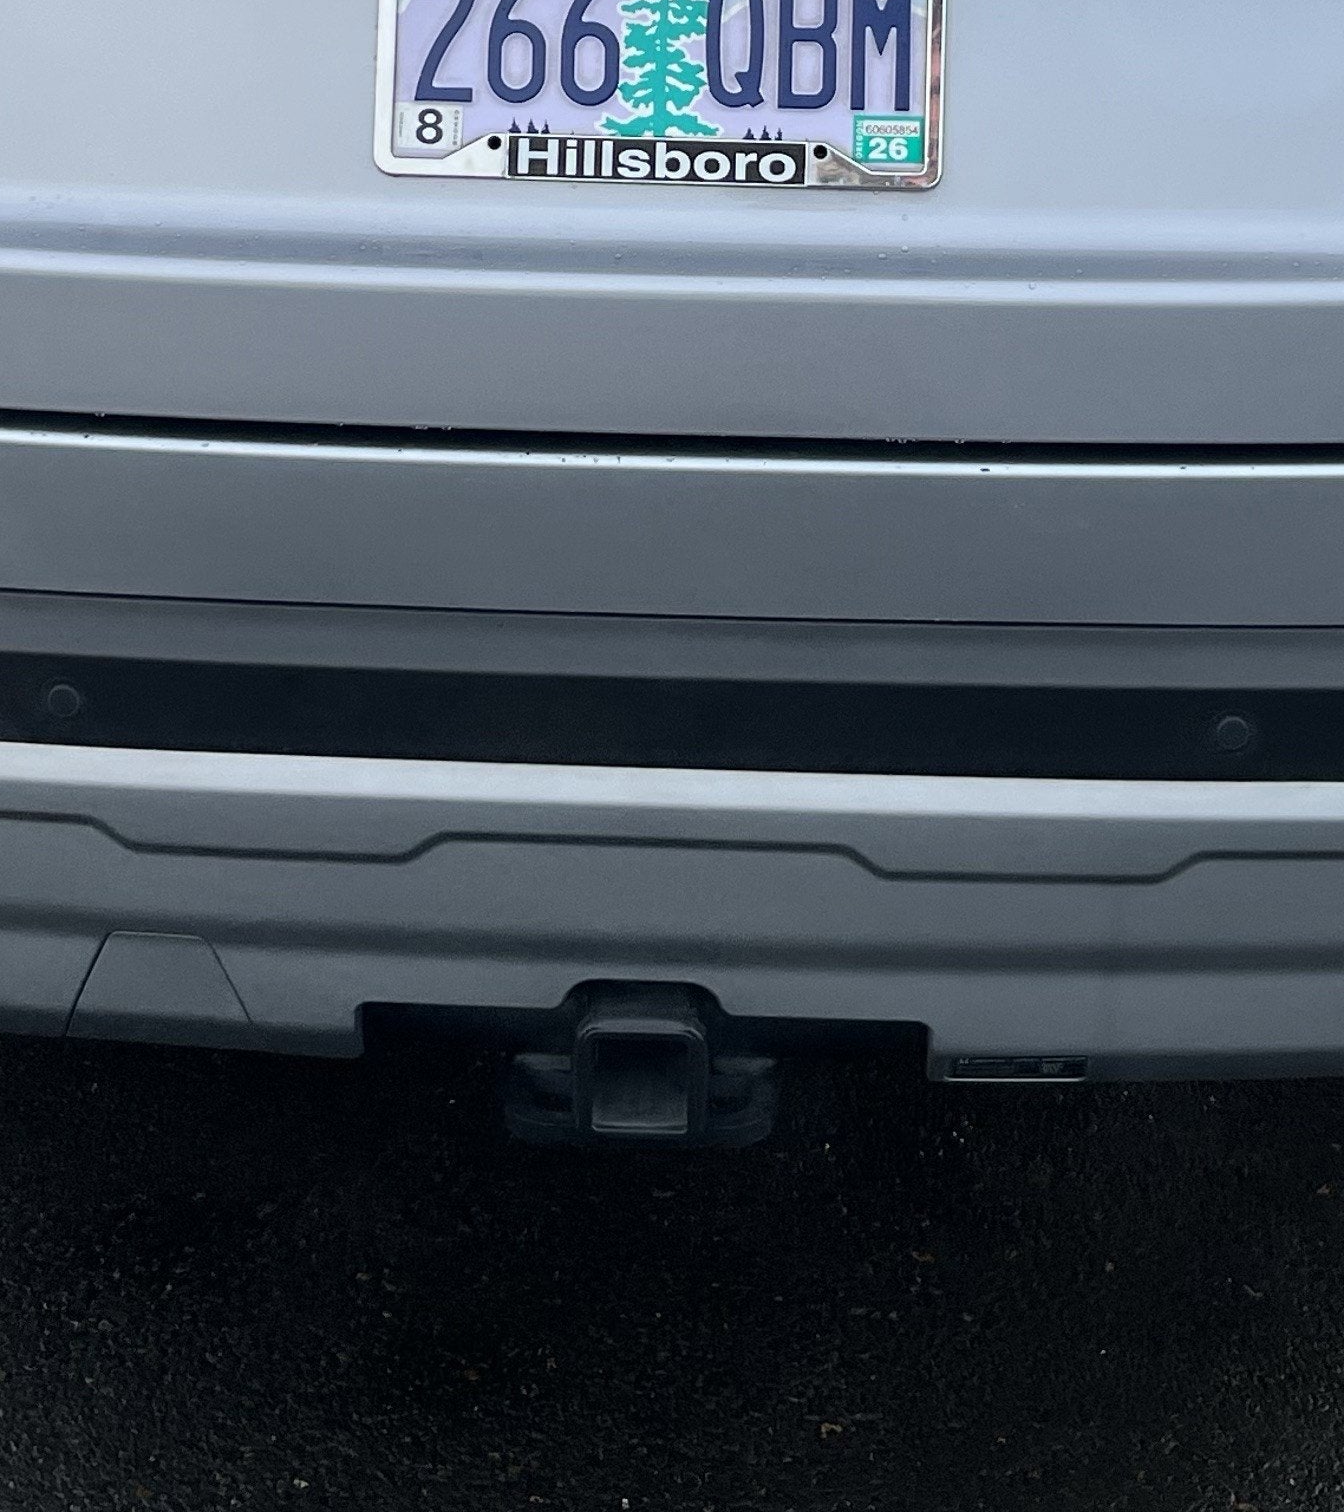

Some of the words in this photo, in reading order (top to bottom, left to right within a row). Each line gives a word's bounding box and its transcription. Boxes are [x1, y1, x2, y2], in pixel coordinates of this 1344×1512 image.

[416, 108, 443, 145] 8
[516, 137, 797, 183] Hillsboro
[868, 136, 908, 161] 26
